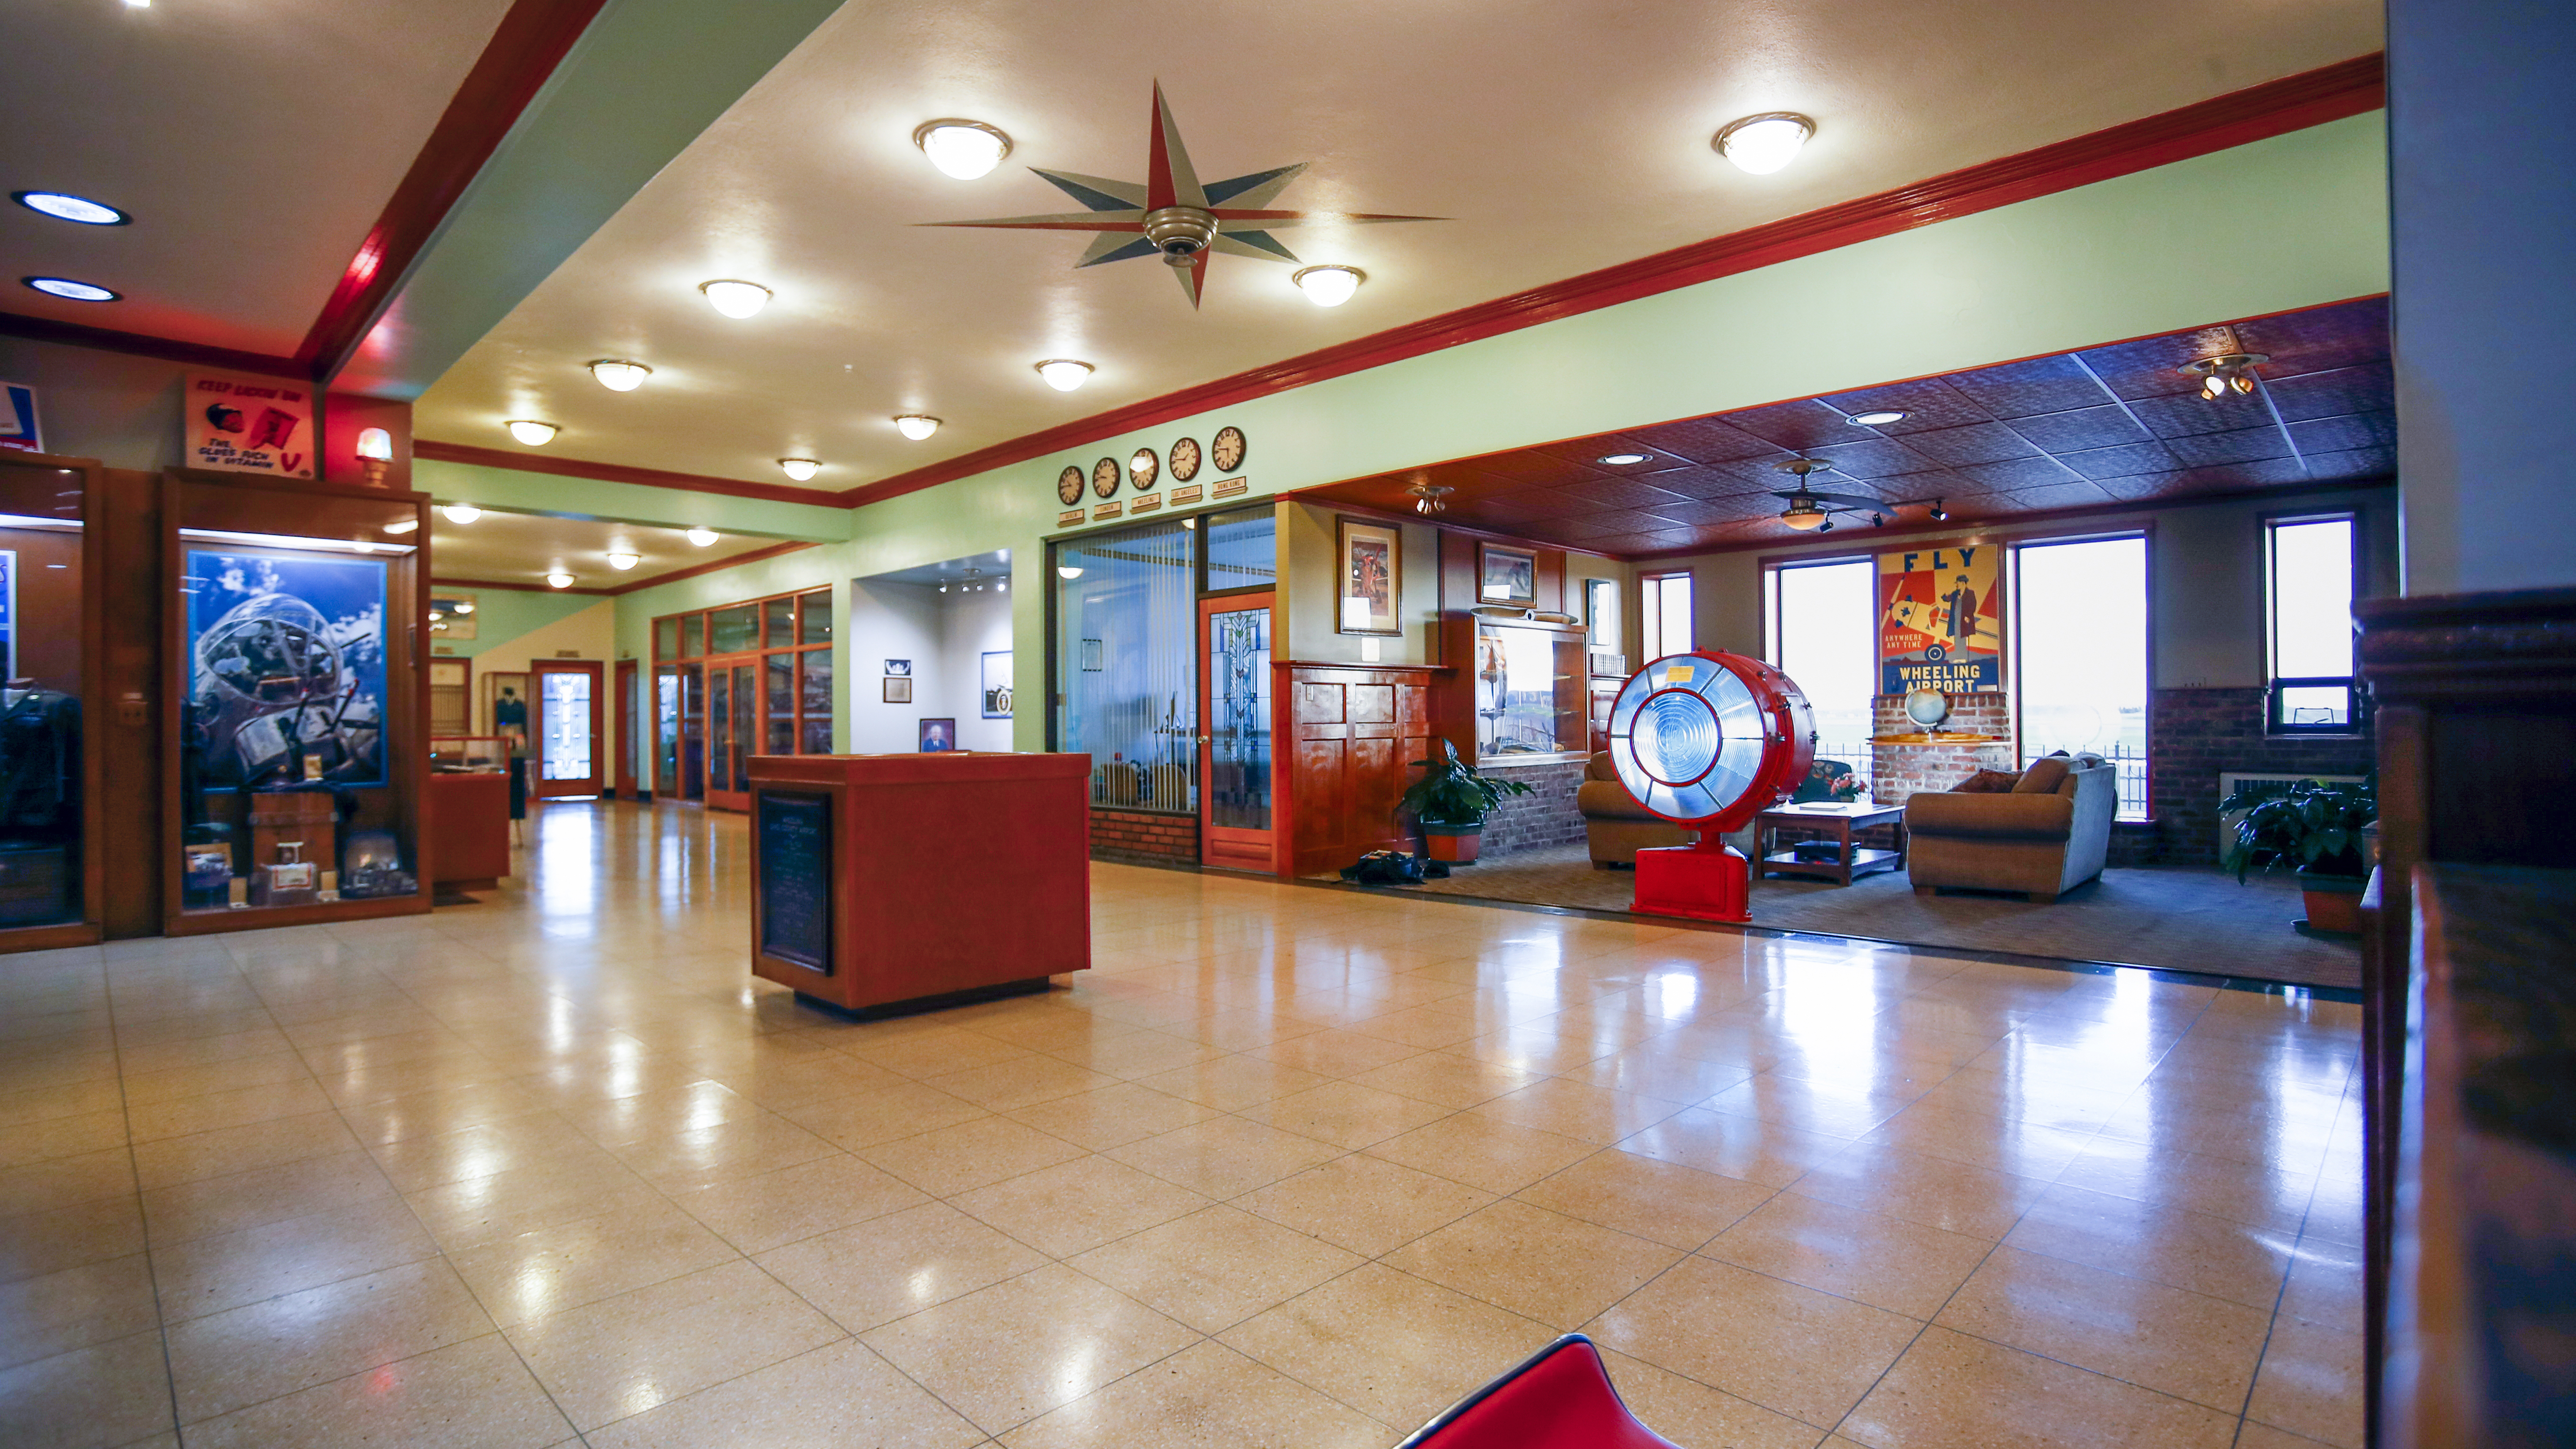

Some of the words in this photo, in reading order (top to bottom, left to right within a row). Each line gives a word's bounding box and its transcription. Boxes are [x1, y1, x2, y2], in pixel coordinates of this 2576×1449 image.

[281, 452, 302, 472] V
[1217, 482, 1228, 490] HONG
[1230, 480, 1240, 488] KONG
[1181, 487, 1197, 495] ANGELES
[1137, 497, 1154, 505] WHEELING
[1904, 547, 1975, 572] FLY
[1885, 633, 1922, 641] ANYWHERE
[1899, 665, 1980, 680] WHEELING
